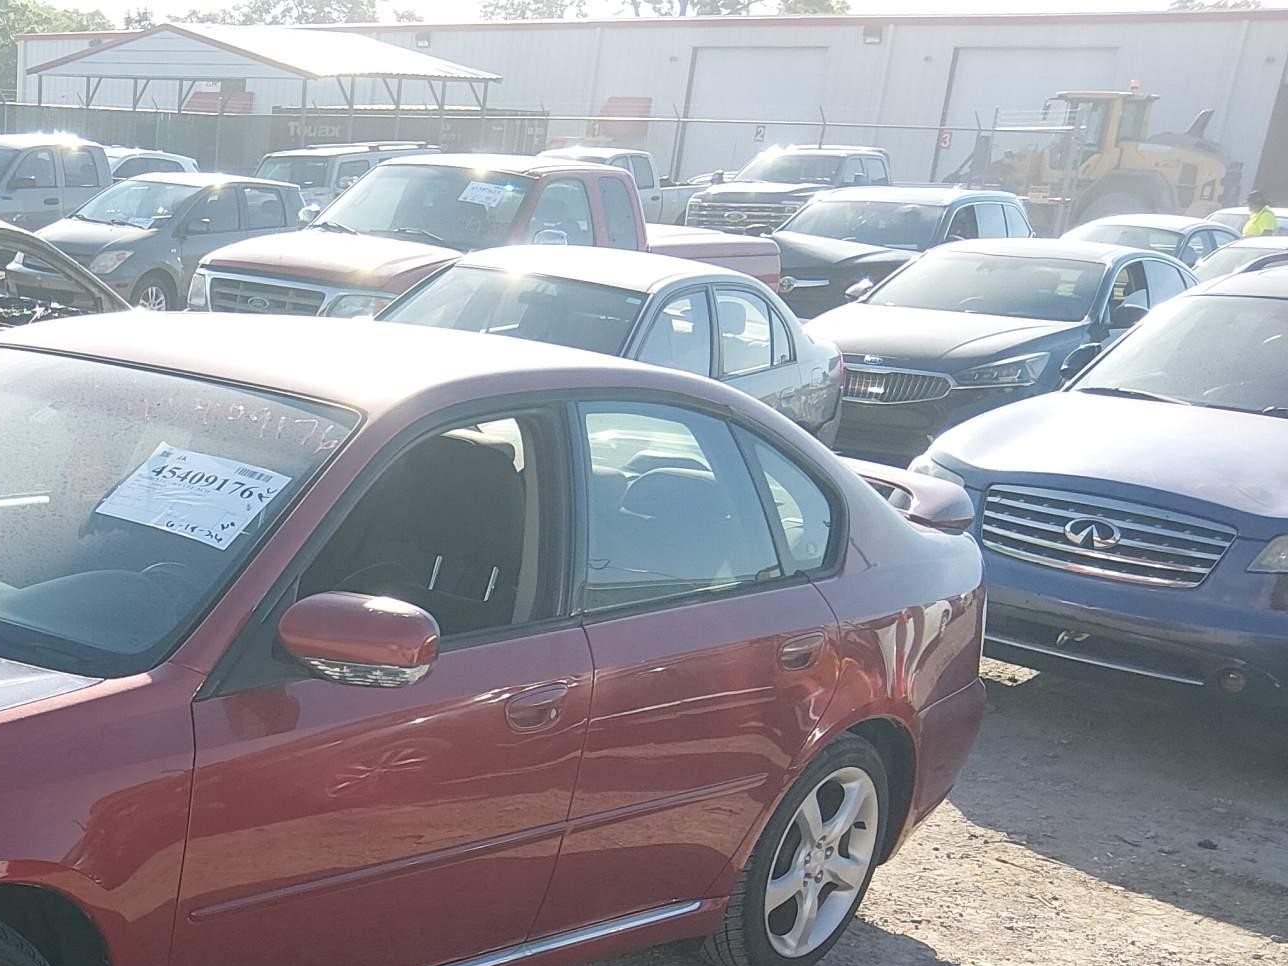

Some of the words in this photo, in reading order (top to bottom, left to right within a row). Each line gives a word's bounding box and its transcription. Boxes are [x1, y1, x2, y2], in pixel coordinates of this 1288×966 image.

[755, 127, 764, 140] 2
[941, 133, 951, 147] 3
[152, 464, 254, 499] 45409176
